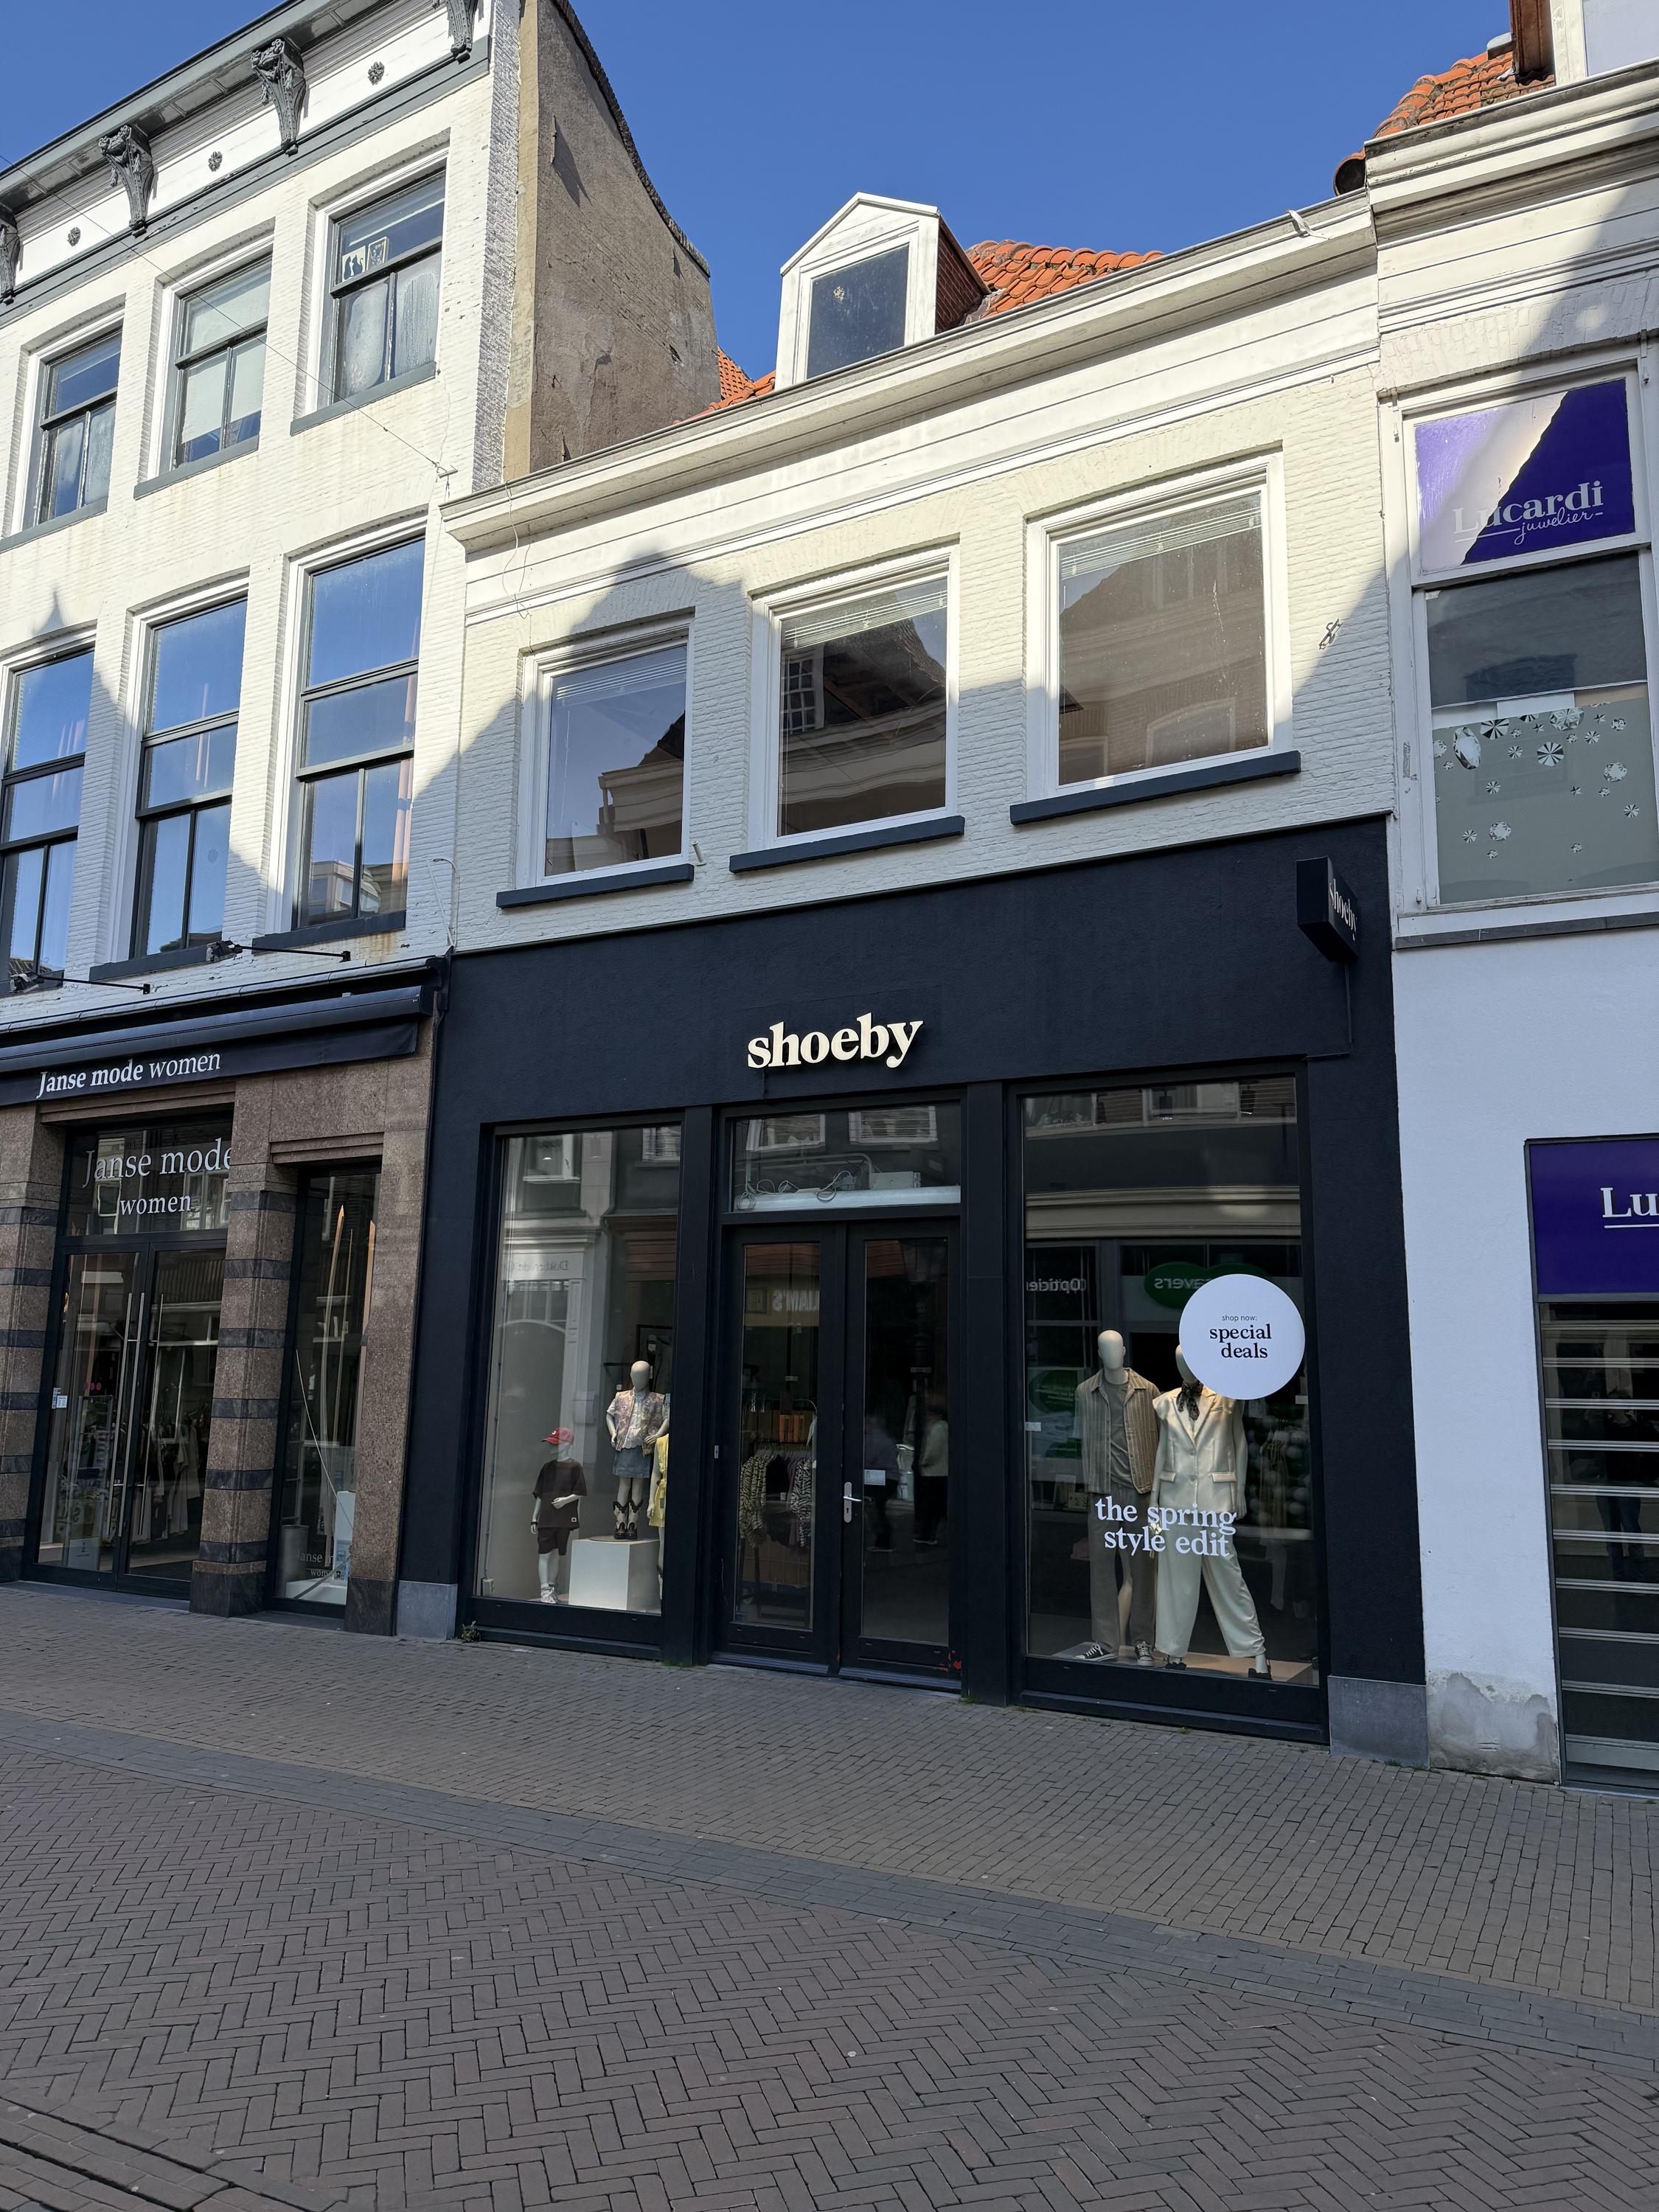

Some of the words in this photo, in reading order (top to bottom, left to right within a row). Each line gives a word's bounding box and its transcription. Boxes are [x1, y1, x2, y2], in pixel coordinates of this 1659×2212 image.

[1453, 480, 1604, 535] Lucardi
[1514, 507, 1594, 546] juwelier
[1329, 878, 1357, 942] shoeby
[747, 1012, 924, 1069] shoeby
[35, 1071, 87, 1099] Janse
[90, 1058, 144, 1087] mode
[149, 1052, 221, 1079] women
[82, 1150, 152, 1189] Janse
[120, 1194, 192, 1217] women
[1209, 1323, 1273, 1343] special
[1220, 1342, 1268, 1359] deals
[1095, 1495, 1138, 1523] the
[1147, 1502, 1237, 1536] spring
[1104, 1526, 1166, 1557] style
[1175, 1529, 1231, 1558] edit
